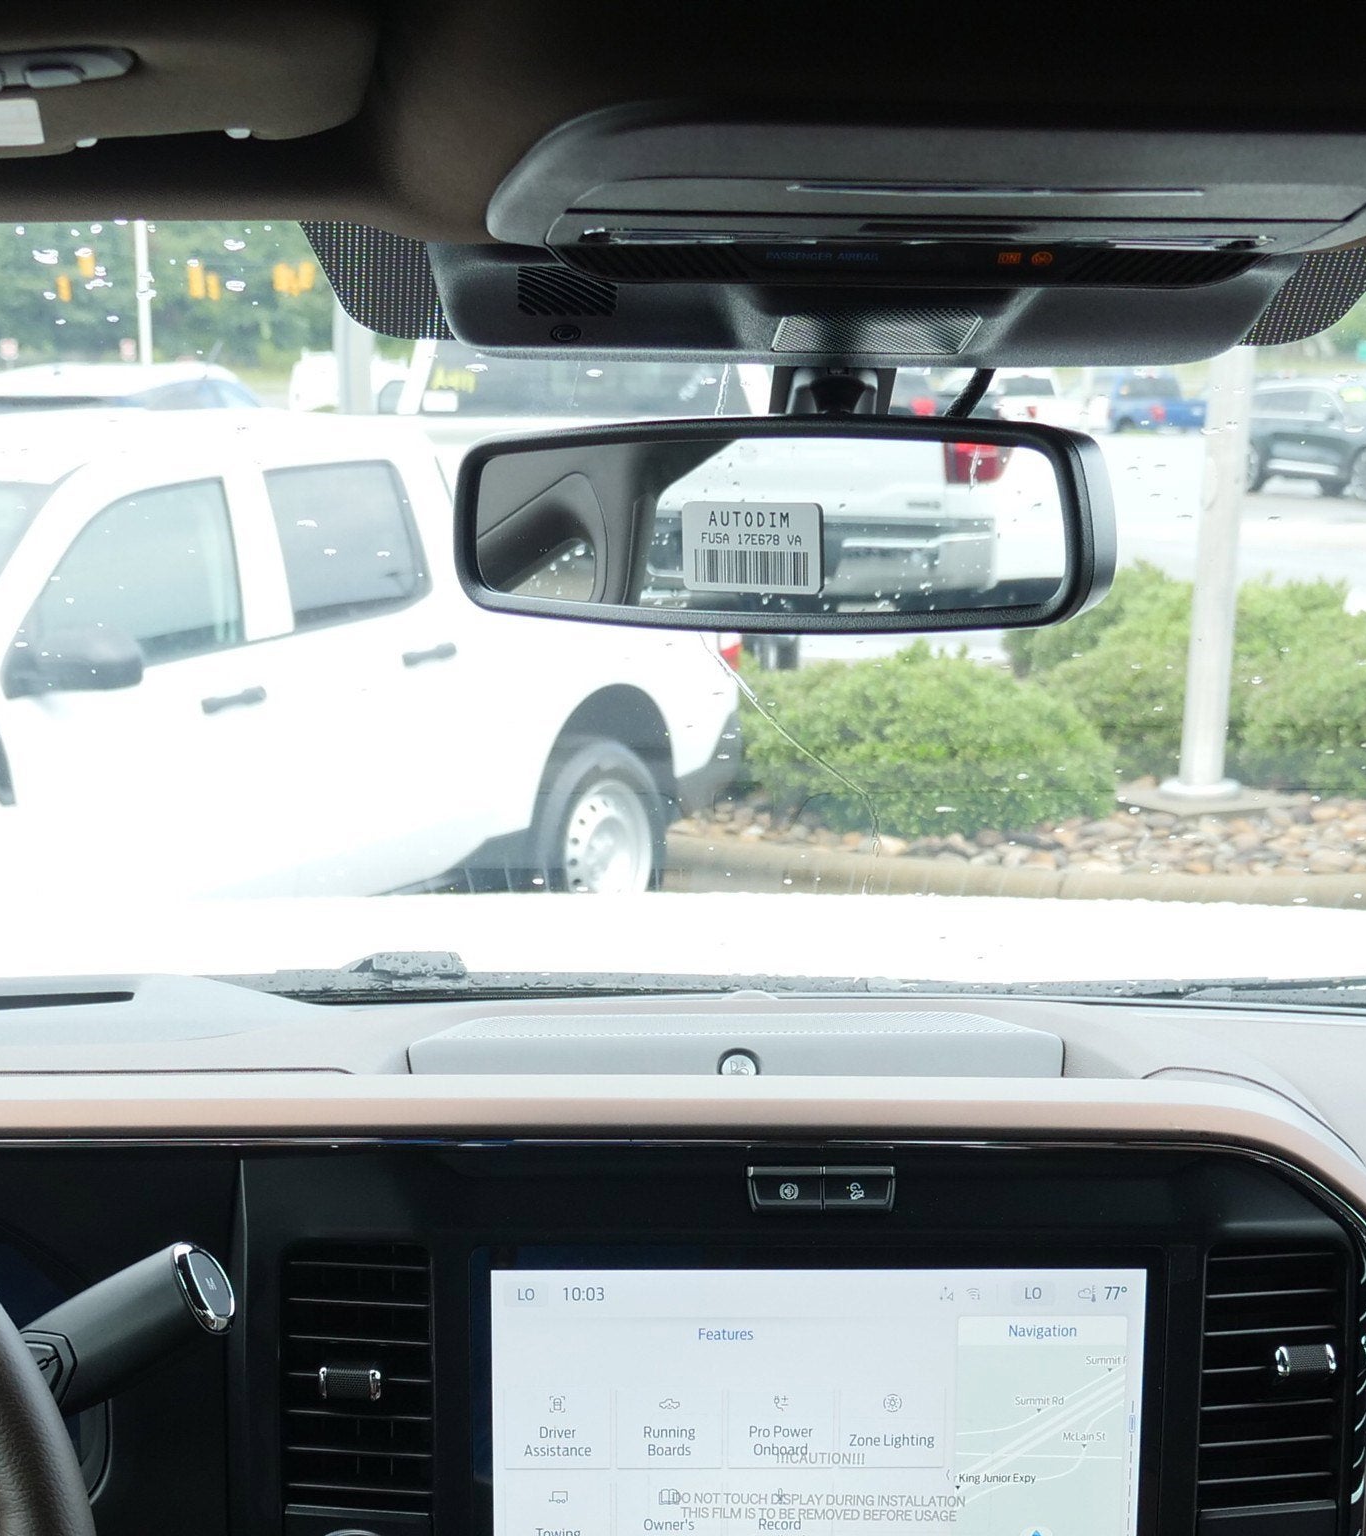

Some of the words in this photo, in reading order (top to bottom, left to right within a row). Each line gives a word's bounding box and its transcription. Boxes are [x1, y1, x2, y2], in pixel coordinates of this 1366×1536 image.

[766, 251, 833, 262] PASSENGER
[708, 510, 791, 528] AUTODIM
[737, 533, 780, 546] 17E678
[787, 534, 802, 546] VA
[517, 1288, 535, 1302] LO
[562, 1286, 605, 1302] 10:03
[1024, 1288, 1043, 1300] LO
[1104, 1286, 1128, 1300] 77°
[697, 1327, 754, 1342] Features
[1008, 1324, 1077, 1340] Navigation
[1085, 1355, 1121, 1366] Summit
[1015, 1396, 1050, 1406] Summit
[1052, 1396, 1065, 1406] Rd
[539, 1426, 577, 1440] Driver
[643, 1426, 696, 1441] Running
[749, 1425, 771, 1439] Pro
[773, 1425, 813, 1439] Power
[1062, 1431, 1095, 1442] McLain
[1096, 1431, 1106, 1442] St
[849, 1434, 881, 1448] Zone
[883, 1434, 935, 1449] Lighting
[523, 1444, 592, 1458] Assistance
[647, 1444, 691, 1457] Boards
[753, 1443, 809, 1456] Onboard
[959, 1473, 981, 1484] King
[983, 1473, 1011, 1483] Junior
[1013, 1473, 1037, 1484] Expy
[675, 1492, 695, 1505] DO
[697, 1492, 721, 1505] NOT
[723, 1492, 768, 1506] TOUCH
[771, 1493, 831, 1506] DISPLAY
[832, 1494, 875, 1507] DURING
[877, 1495, 966, 1508] INSTALLATION
[681, 1506, 710, 1519] THIS
[712, 1507, 742, 1520] FILM
[745, 1507, 757, 1520] IS
[759, 1508, 776, 1520] TO
[779, 1508, 795, 1520] BE
[798, 1508, 860, 1521] REMOVED
[863, 1509, 913, 1522] BEFORE
[915, 1510, 957, 1522] USAGE
[643, 1518, 695, 1532] Owner's
[758, 1518, 802, 1531] Record
